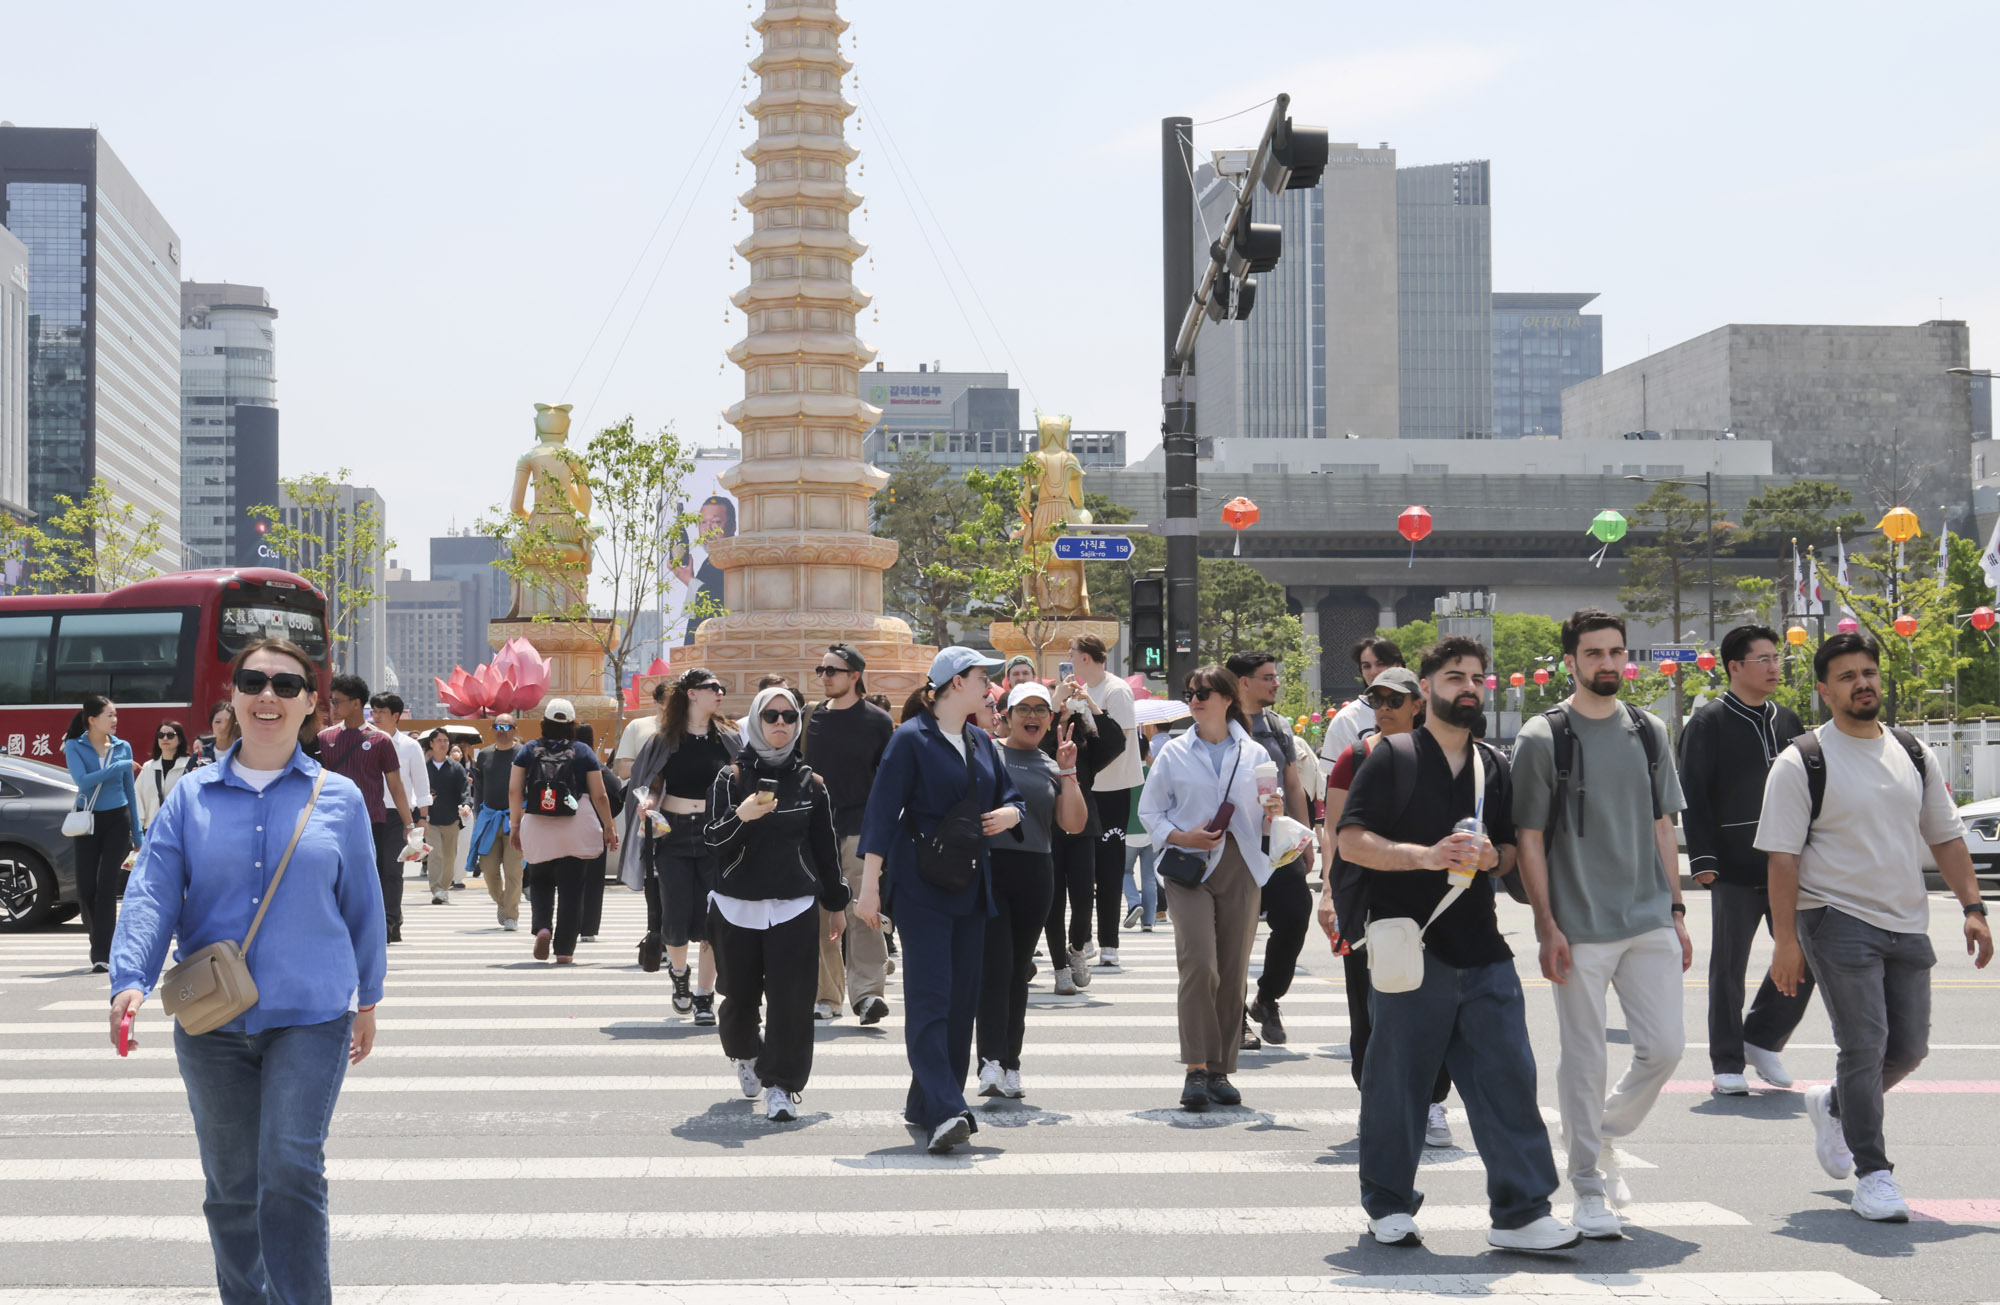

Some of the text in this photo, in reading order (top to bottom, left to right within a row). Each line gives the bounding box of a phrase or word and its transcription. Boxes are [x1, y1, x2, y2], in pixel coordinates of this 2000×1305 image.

[1080, 540, 1107, 550] 사직로
[1116, 545, 1129, 553] 158
[1080, 550, 1106, 558] Sajik-ro
